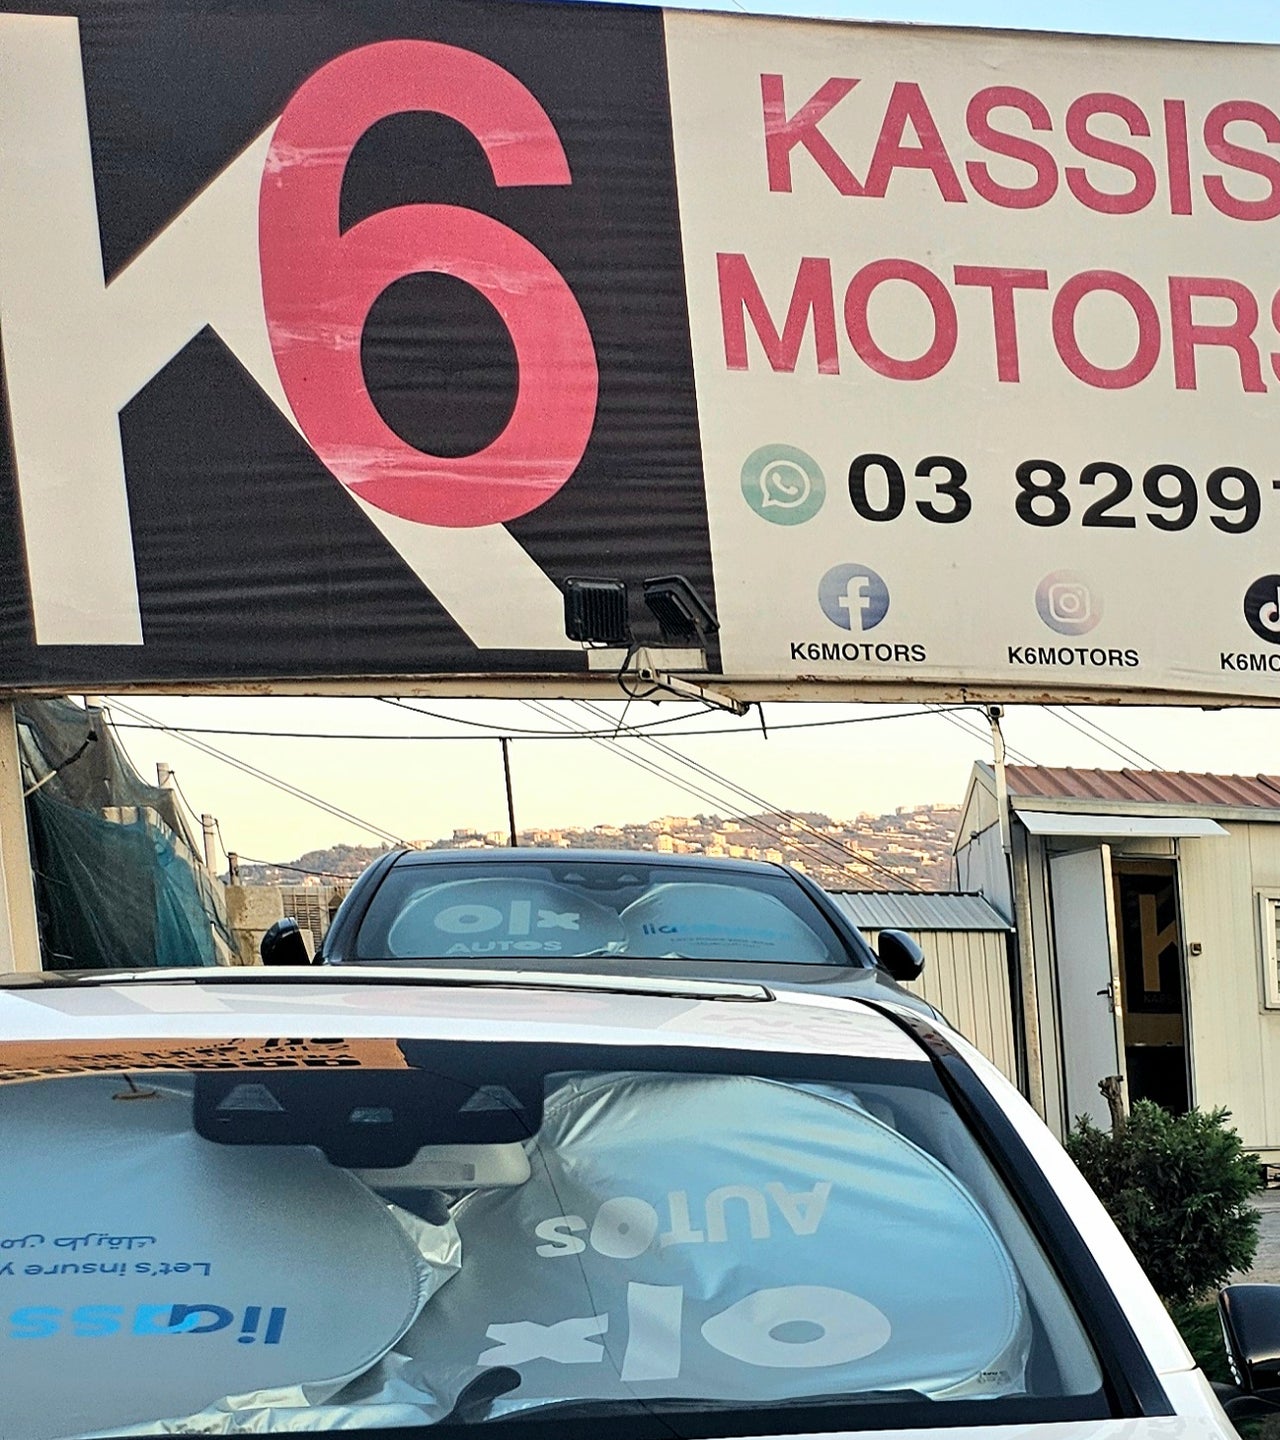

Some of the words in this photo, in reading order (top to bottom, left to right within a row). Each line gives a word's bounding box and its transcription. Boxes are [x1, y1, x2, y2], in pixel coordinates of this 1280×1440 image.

[848, 453, 972, 524] 03
[790, 642, 926, 663] K6MOTORS
[1007, 646, 1139, 668] K6MOTORS
[446, 940, 562, 954] AUTOS
[535, 1182, 833, 1259] AUTOS
[25, 1262, 126, 1276] insure
[135, 1262, 211, 1277] Let's
